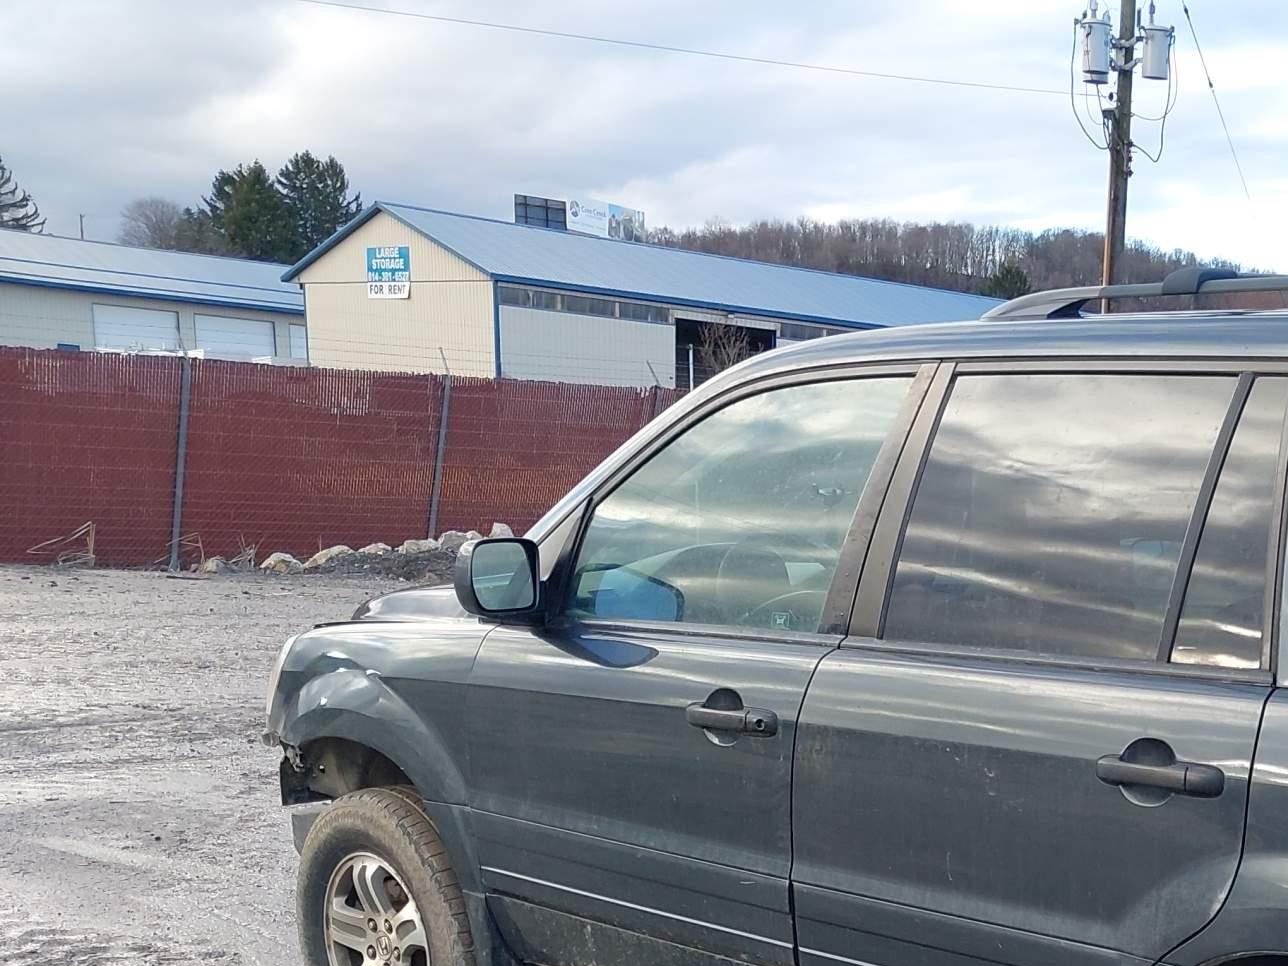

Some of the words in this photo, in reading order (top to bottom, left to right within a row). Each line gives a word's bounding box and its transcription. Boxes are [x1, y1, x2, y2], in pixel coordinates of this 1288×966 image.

[376, 247, 399, 258] LARGE
[372, 258, 404, 269] STORAGE
[369, 284, 384, 295] FOR
[387, 284, 406, 295] RENT
